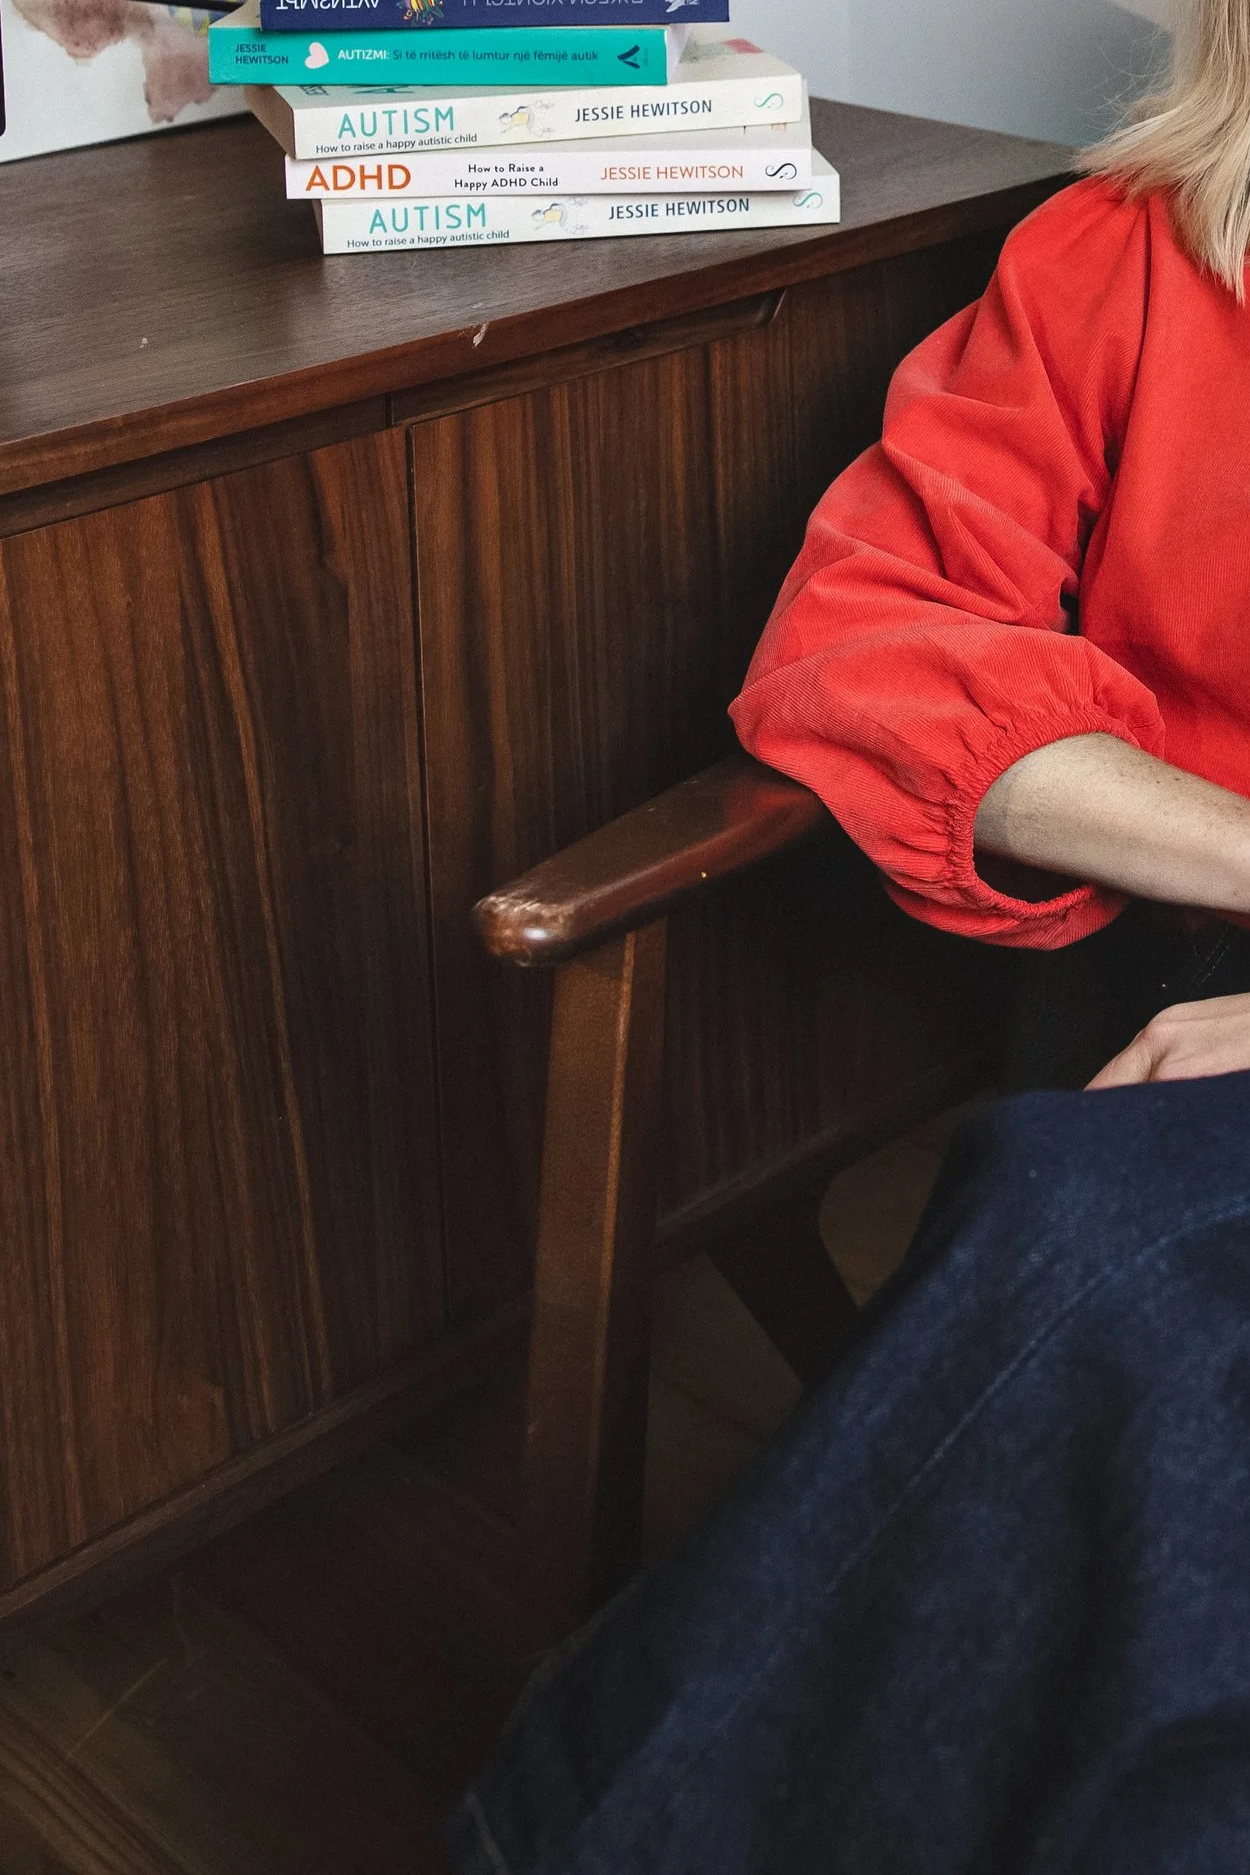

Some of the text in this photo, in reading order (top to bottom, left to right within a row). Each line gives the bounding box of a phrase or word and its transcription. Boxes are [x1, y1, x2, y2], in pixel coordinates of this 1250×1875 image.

[235, 43, 267, 53] JESSIE
[338, 49, 598, 62] AUTIZMI: Si të rritësh të lumtur një fëmijë autik
[235, 55, 289, 65] HEWITSON
[574, 99, 712, 122] JESSIE HEWITSON
[338, 106, 454, 139] AUTISM
[316, 144, 338, 153] How
[340, 143, 351, 152] to
[353, 141, 376, 151] raise
[386, 138, 416, 151] happy
[418, 135, 452, 147] autistic
[454, 133, 478, 143] child
[305, 164, 412, 192] ADHD
[468, 164, 492, 173] How
[494, 165, 504, 173] to
[508, 163, 535, 173] Raise
[600, 165, 743, 181] JESSIE HEWITSON
[454, 177, 558, 191] Happy ADHD Child
[369, 203, 487, 235] AUTISM
[609, 199, 750, 221] JESSIE HEWITSON
[347, 239, 370, 249] How
[372, 237, 382, 247] to
[384, 236, 407, 245] raise
[417, 234, 448, 246] happy
[450, 231, 484, 242] autistic
[486, 229, 510, 239] child
